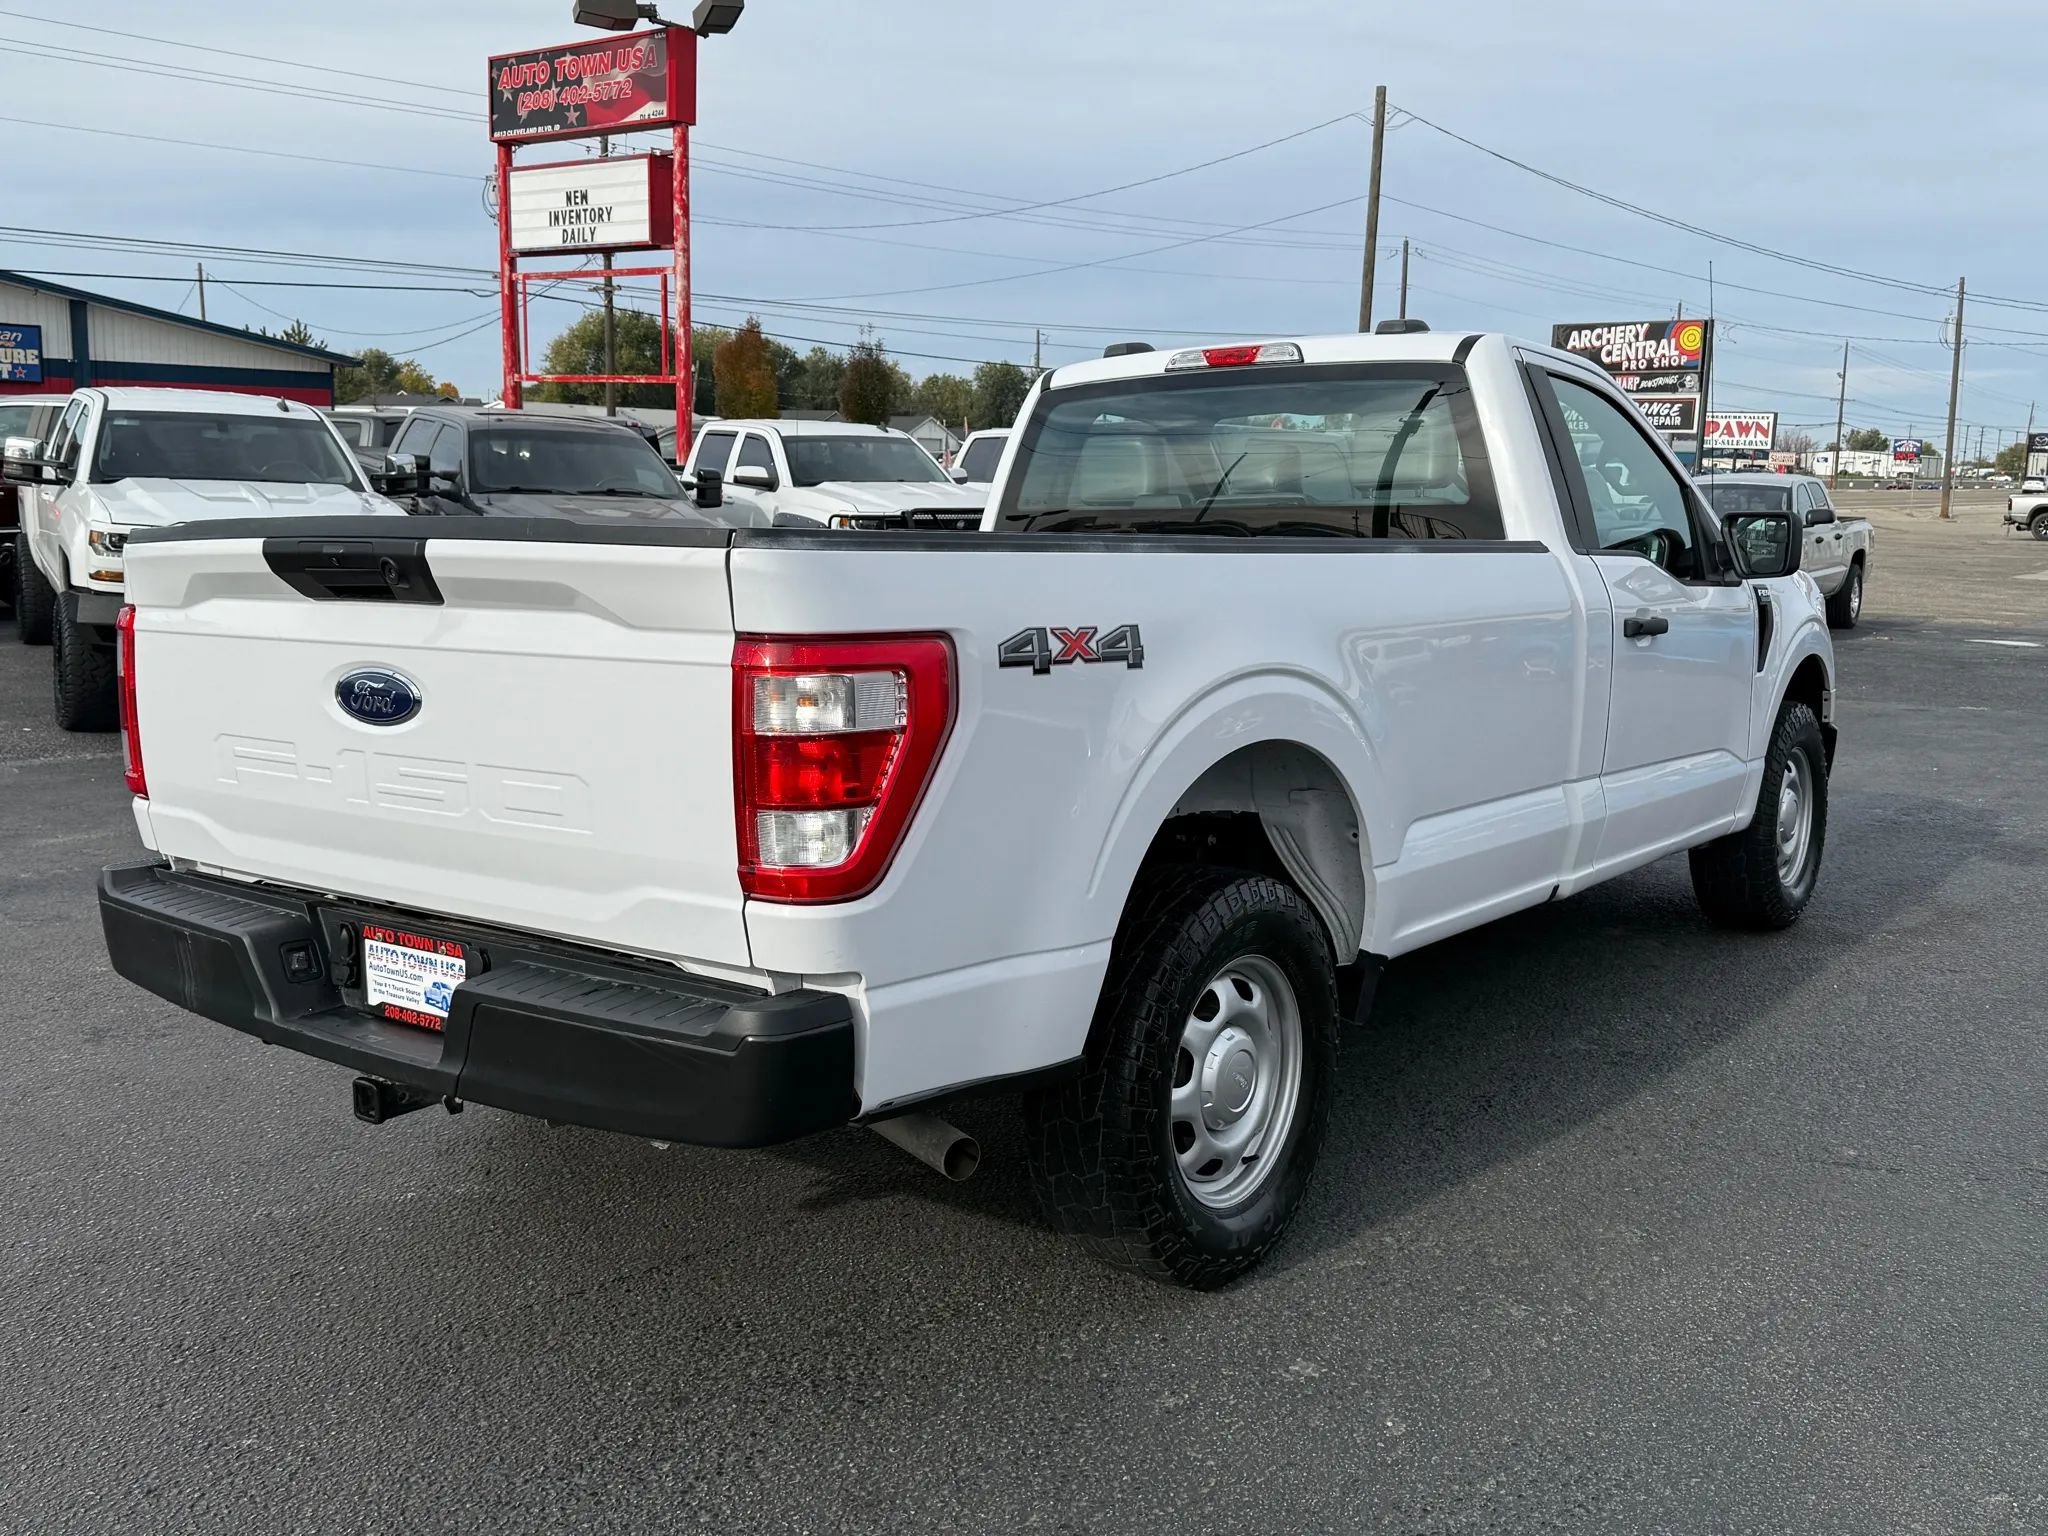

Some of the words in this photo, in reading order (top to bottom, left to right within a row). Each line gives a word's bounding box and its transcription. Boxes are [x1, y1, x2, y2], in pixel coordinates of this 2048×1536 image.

[498, 60, 550, 90] AUTO
[555, 51, 611, 82] TOWN
[616, 45, 657, 73] USA
[517, 88, 556, 116] (208)
[559, 78, 632, 106] 402-5772
[507, 127, 537, 136] CLEVELAND
[565, 189, 588, 207] NEW
[549, 206, 613, 227] INVENTORY
[562, 226, 597, 244] DAILY
[1566, 323, 1650, 350] ARCHERY
[1600, 338, 1680, 364] CENTRAL
[1621, 358, 1647, 371] PRO
[1652, 355, 1688, 368] SHOP
[1615, 375, 1641, 391] HARP
[1704, 420, 1771, 439] PAWN
[350, 679, 396, 713] Ford
[213, 732, 594, 835] F-150
[363, 926, 395, 943] AUTO
[398, 932, 434, 951] TOWN
[437, 940, 464, 958] USA
[368, 944, 399, 965] AUTO
[400, 951, 438, 975] TOWN
[440, 960, 466, 980] USA
[368, 961, 424, 982] AutoTownUS.com
[386, 990, 405, 1000] Treasure
[406, 995, 419, 1005] Valley
[392, 984, 404, 992] Truck
[405, 988, 421, 996] Source
[384, 1005, 441, 1030] 208-402-5772
